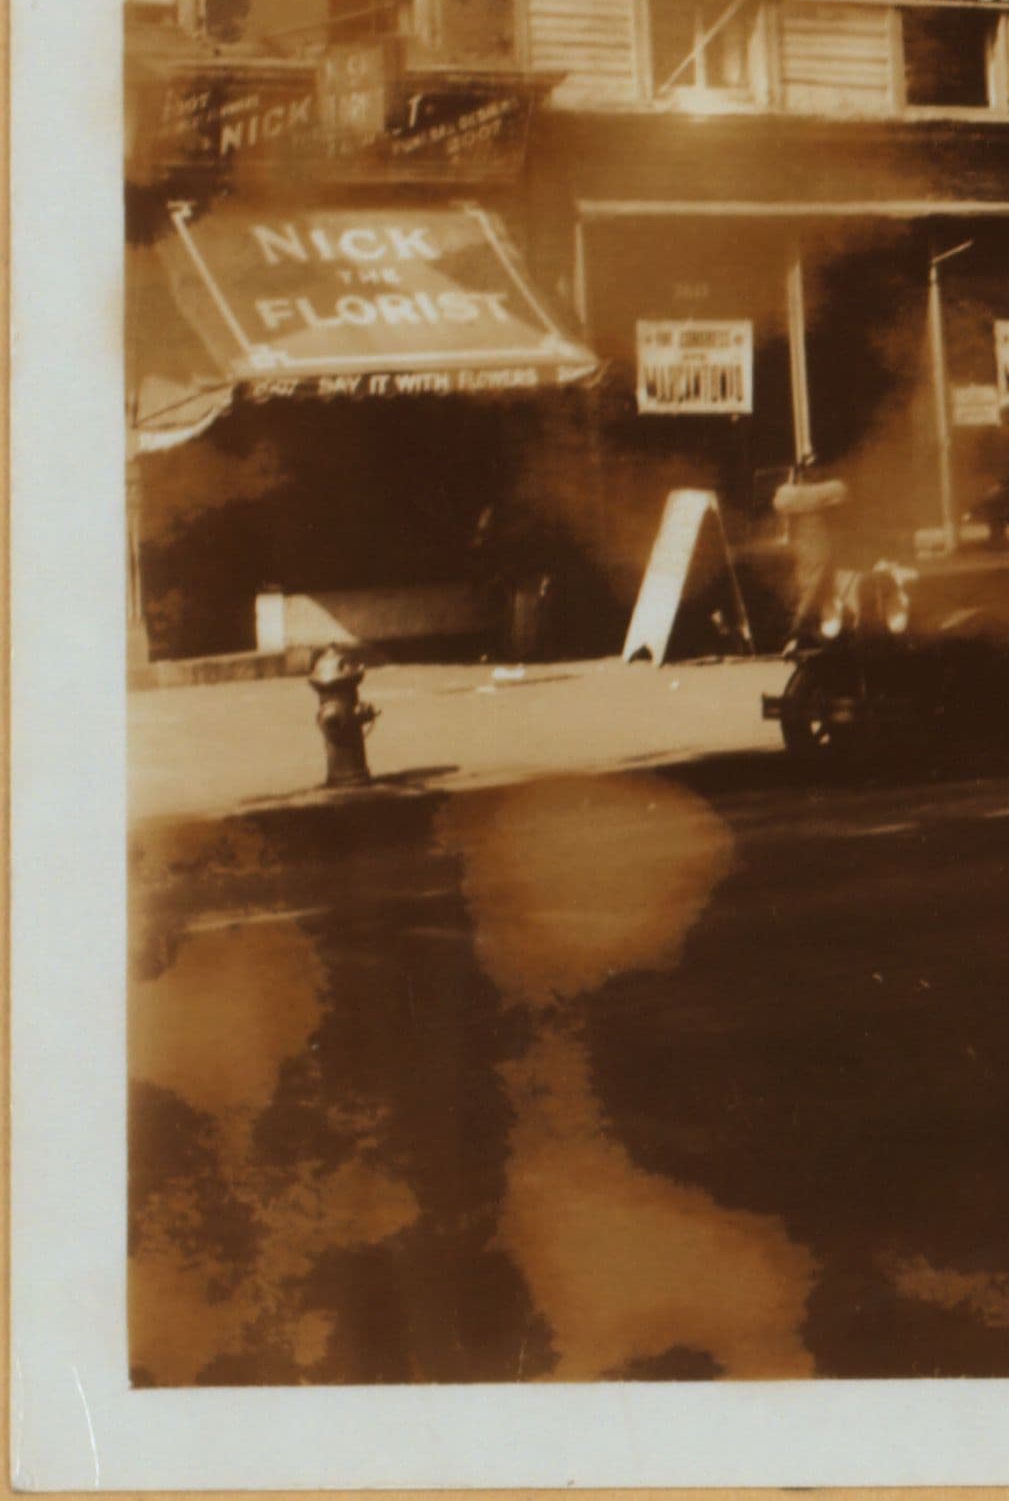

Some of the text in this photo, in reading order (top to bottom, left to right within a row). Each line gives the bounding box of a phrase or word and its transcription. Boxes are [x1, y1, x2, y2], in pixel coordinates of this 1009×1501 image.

[219, 94, 312, 157] NICK
[250, 223, 441, 266] NICK
[335, 267, 399, 285] THE
[255, 292, 509, 330] FLORIST
[369, 374, 390, 396] IT
[395, 372, 449, 396] WITH
